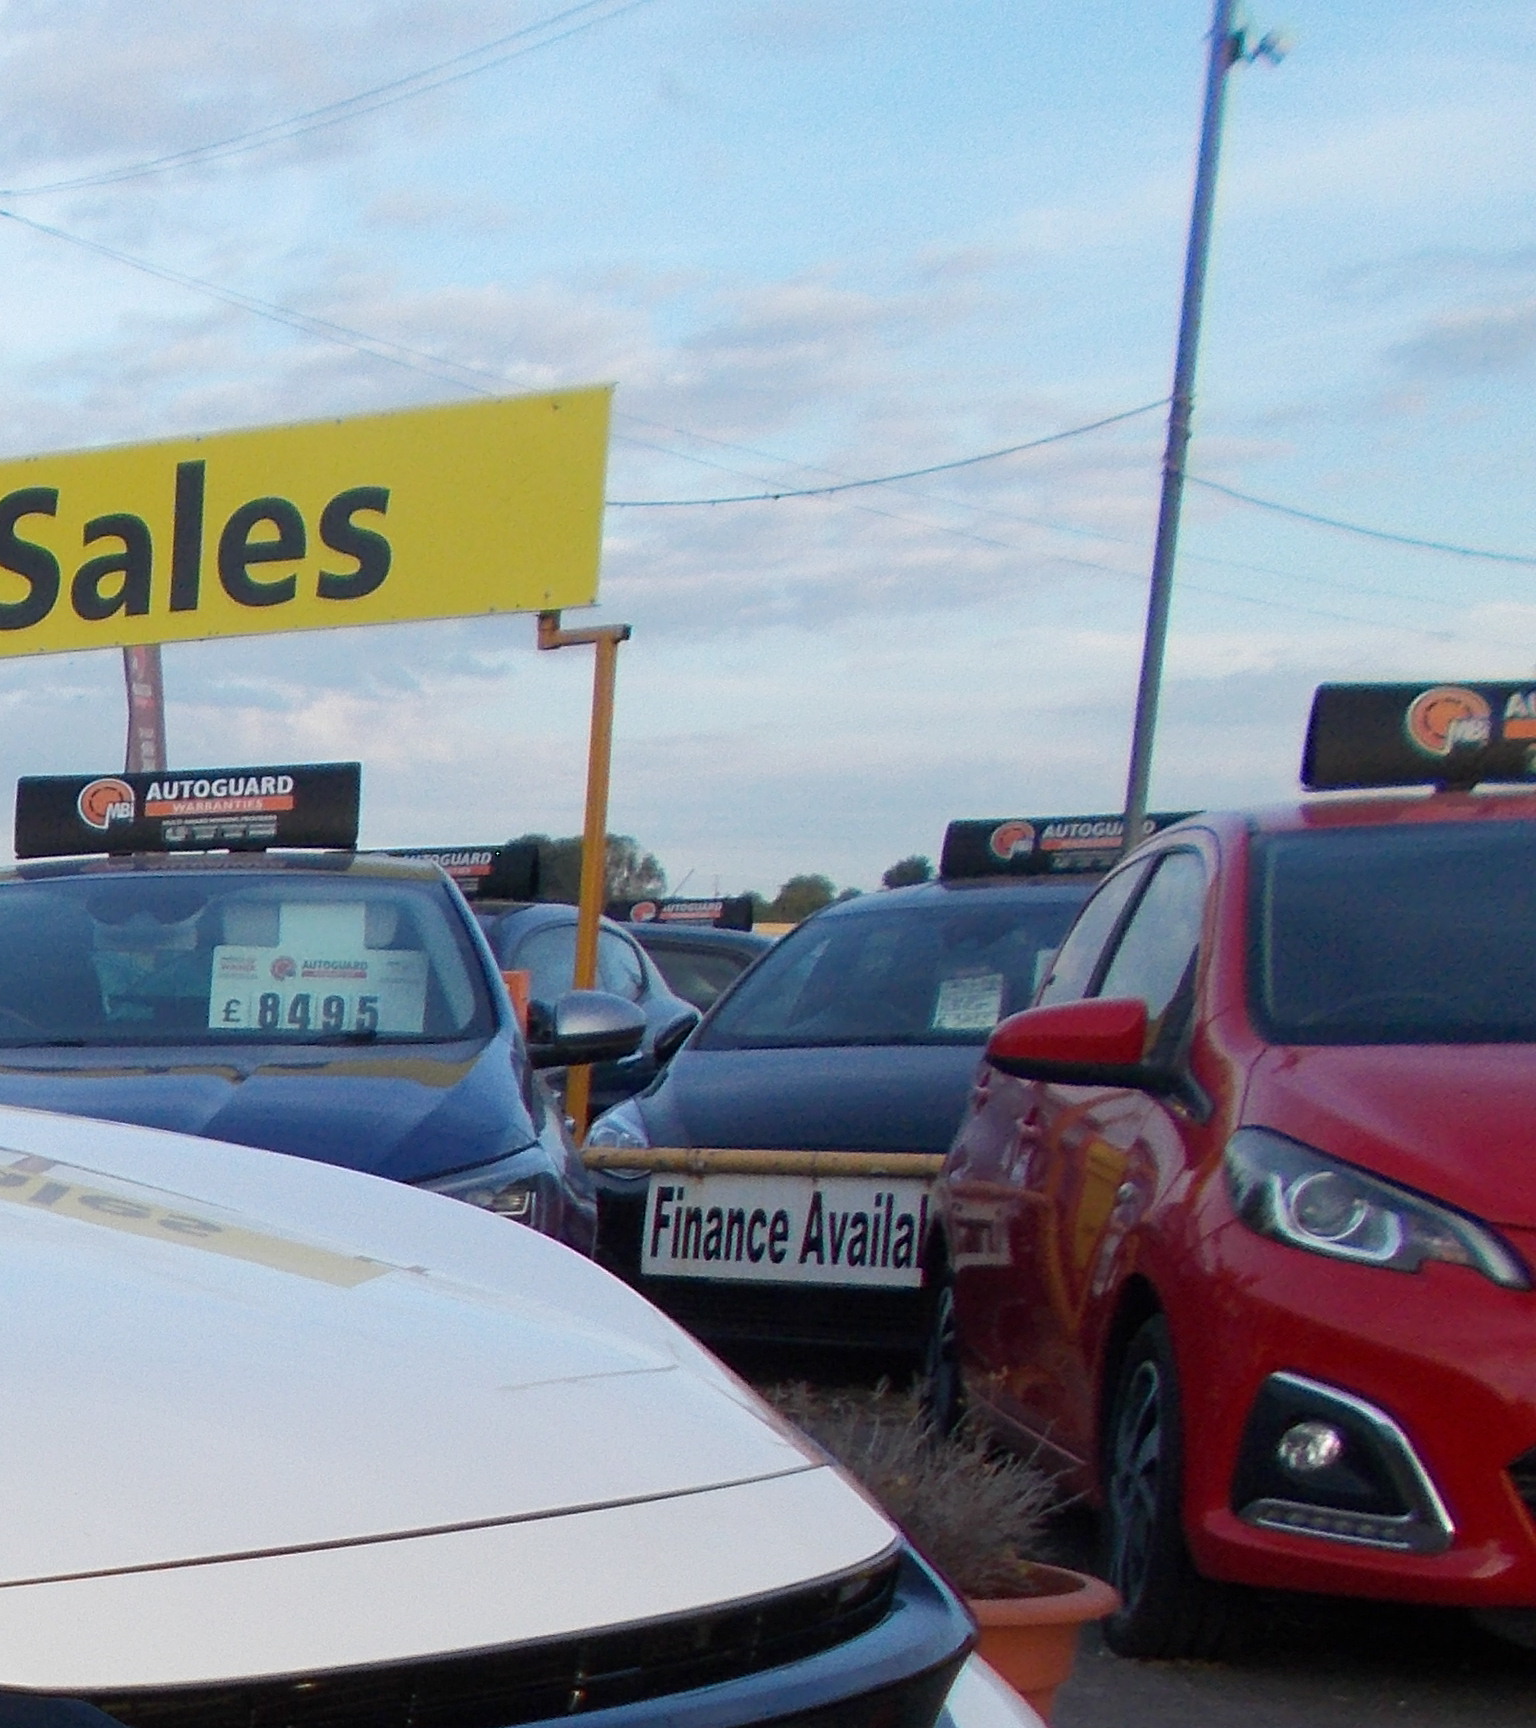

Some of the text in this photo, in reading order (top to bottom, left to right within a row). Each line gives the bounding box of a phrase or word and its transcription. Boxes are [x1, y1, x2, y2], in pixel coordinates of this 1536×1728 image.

[146, 776, 294, 801] AUTOGUARD
[172, 799, 264, 813] WARRANTIES
[650, 1186, 789, 1264] Finance
